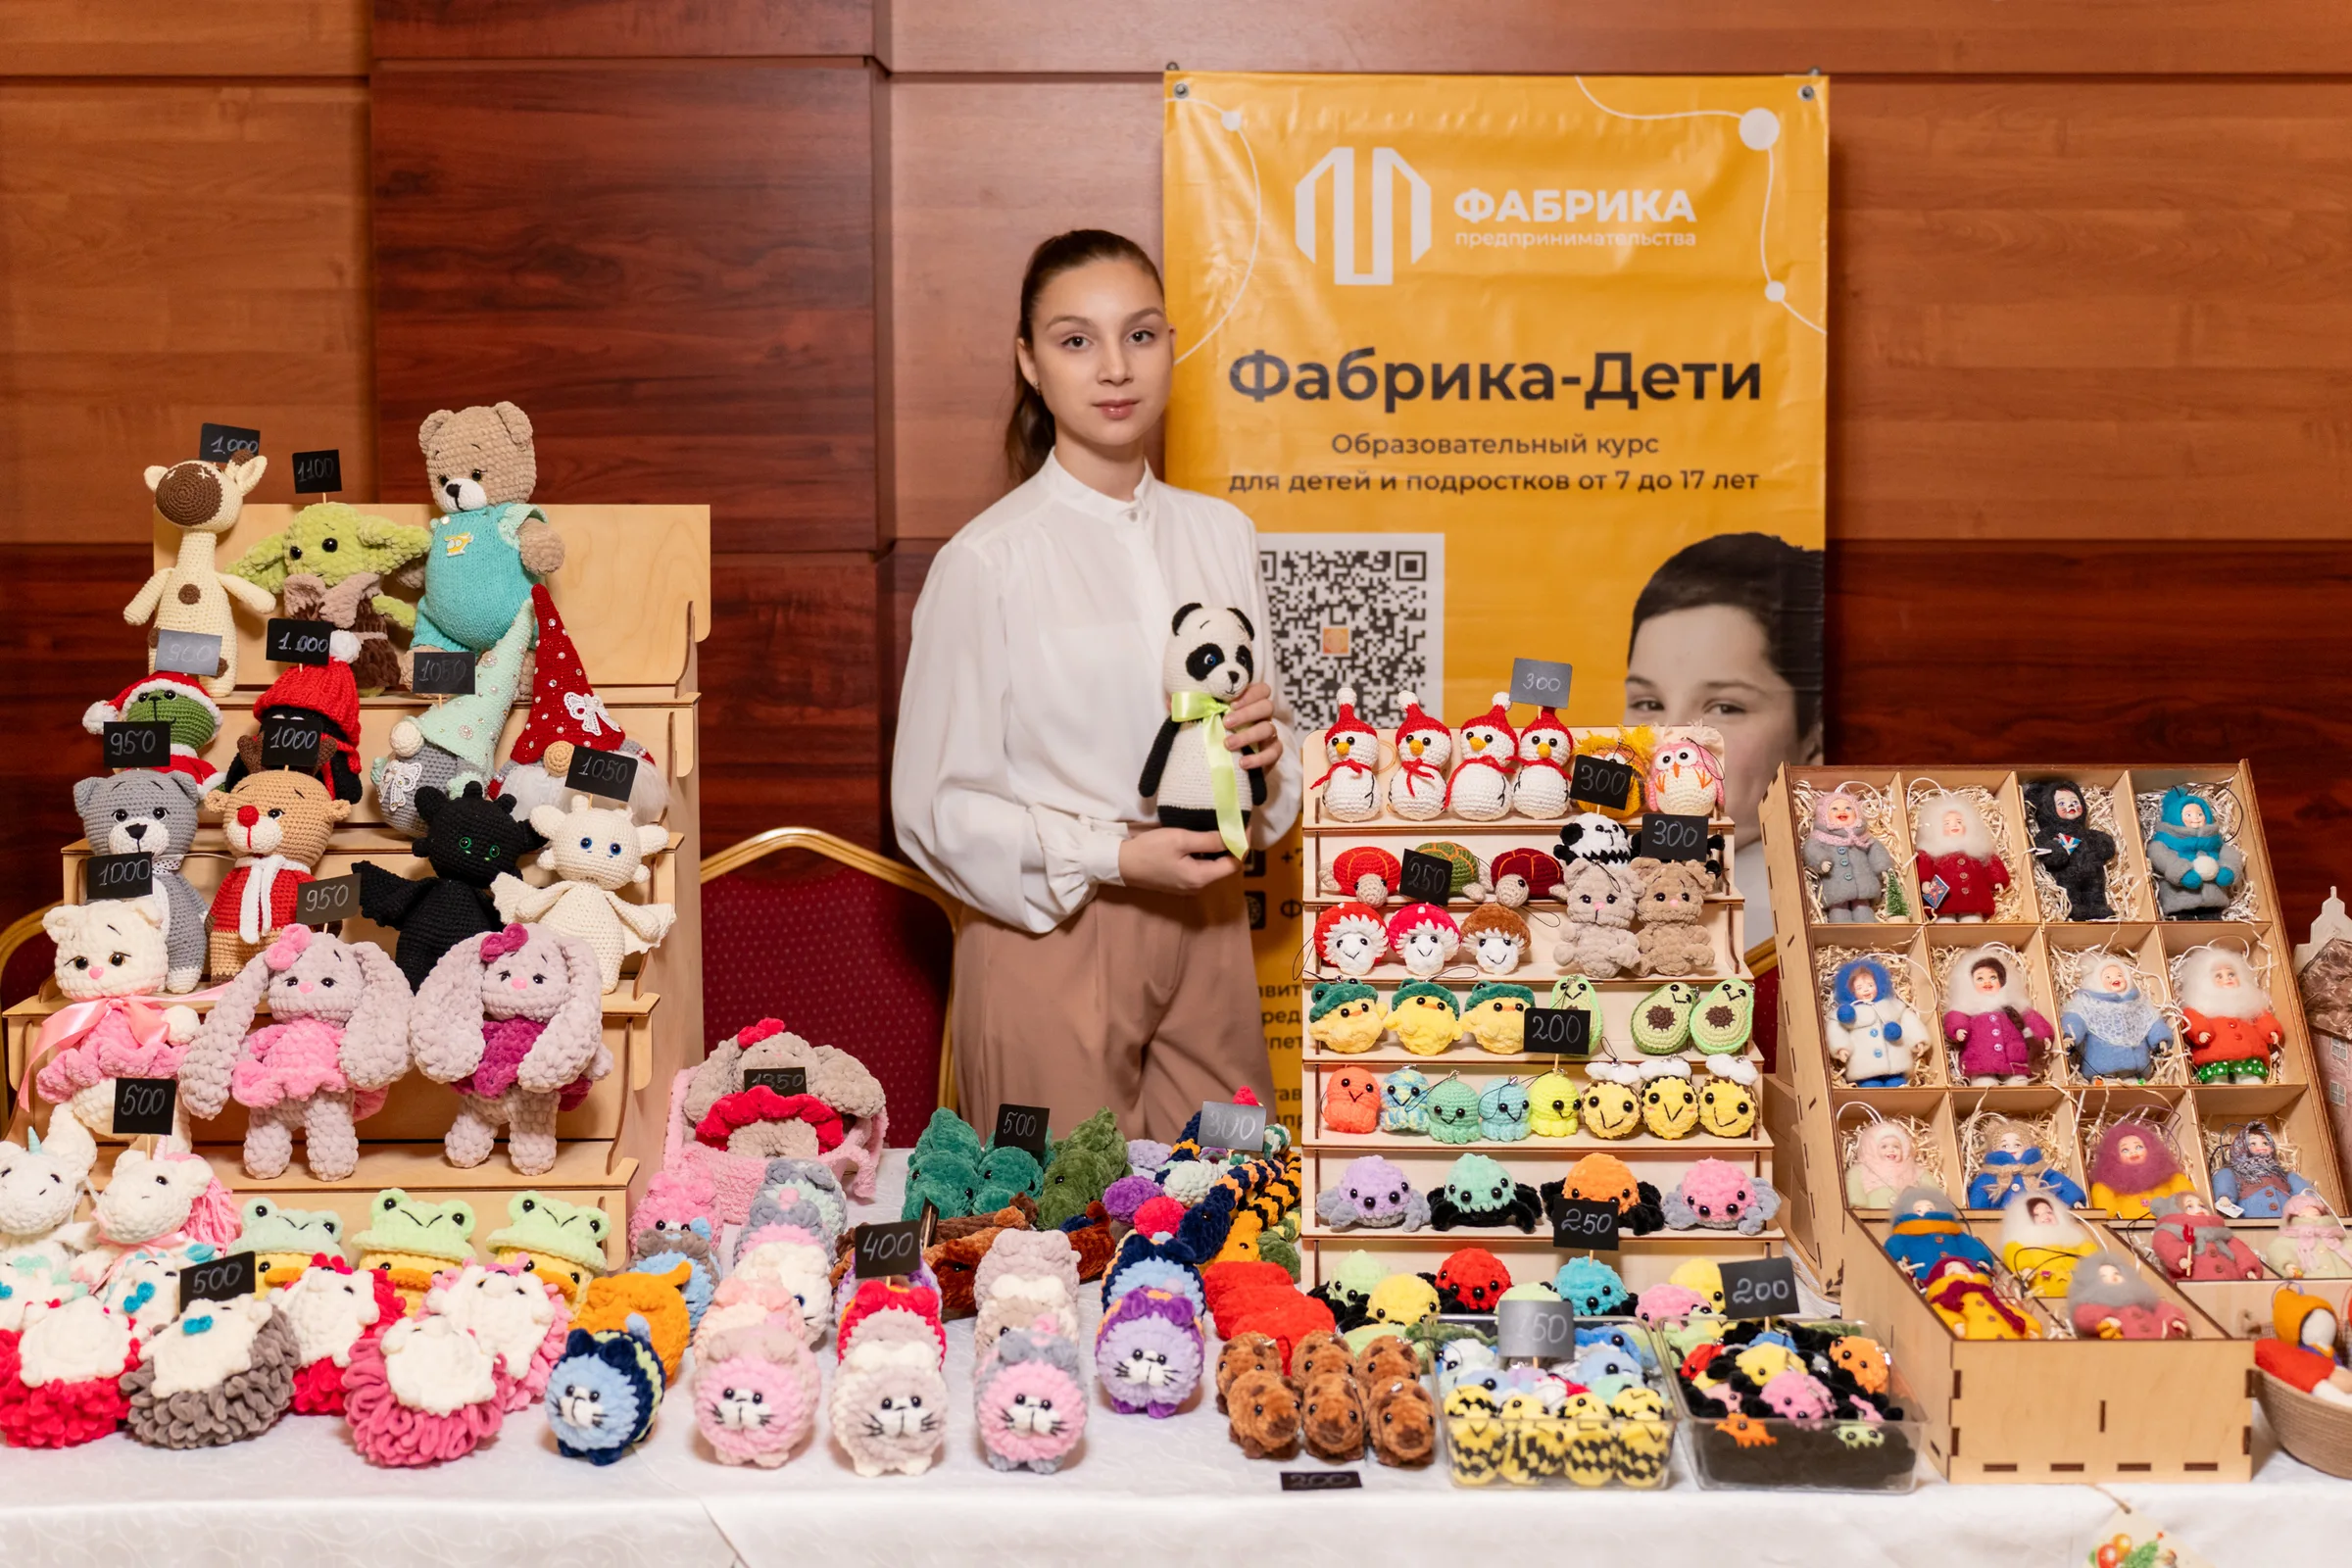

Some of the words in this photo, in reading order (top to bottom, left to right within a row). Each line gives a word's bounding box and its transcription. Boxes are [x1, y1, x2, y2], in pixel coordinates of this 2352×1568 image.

[1453, 187, 1697, 223] ФАБРИКА
[1454, 231, 1696, 248] предпринимательства
[1229, 346, 1761, 414] Фабрика-Дети
[1331, 432, 1588, 459] Образовательный
[1596, 437, 1659, 459] курс
[298, 458, 335, 483] 1100
[1228, 474, 1280, 494] для
[1288, 469, 1371, 494] детей
[1381, 475, 1397, 490] и
[1406, 474, 1570, 494] подростков
[1578, 474, 1607, 490] от
[1615, 470, 1631, 490] 7
[1637, 473, 1673, 493] до
[1680, 469, 1706, 490] 17
[1712, 473, 1760, 490] лет
[418, 658, 467, 683] 1050
[1522, 672, 1561, 692] 300
[110, 729, 157, 757] 950
[270, 725, 318, 750] 1000
[577, 756, 628, 784] 1050
[1580, 763, 1628, 796] 300
[1651, 819, 1699, 849] 300
[98, 858, 150, 887] 1000
[1407, 861, 1446, 895] 250
[305, 883, 349, 912] 950
[1532, 1013, 1582, 1044] 200
[751, 1072, 805, 1090] 1350
[121, 1083, 167, 1115] 500
[1003, 1111, 1037, 1137] 500
[1205, 1109, 1256, 1142] 300
[1561, 1207, 1613, 1236] 250
[862, 1230, 913, 1262] 400
[192, 1260, 243, 1295] 500
[1732, 1277, 1789, 1303] 200
[1289, 1473, 1352, 1489] 200
